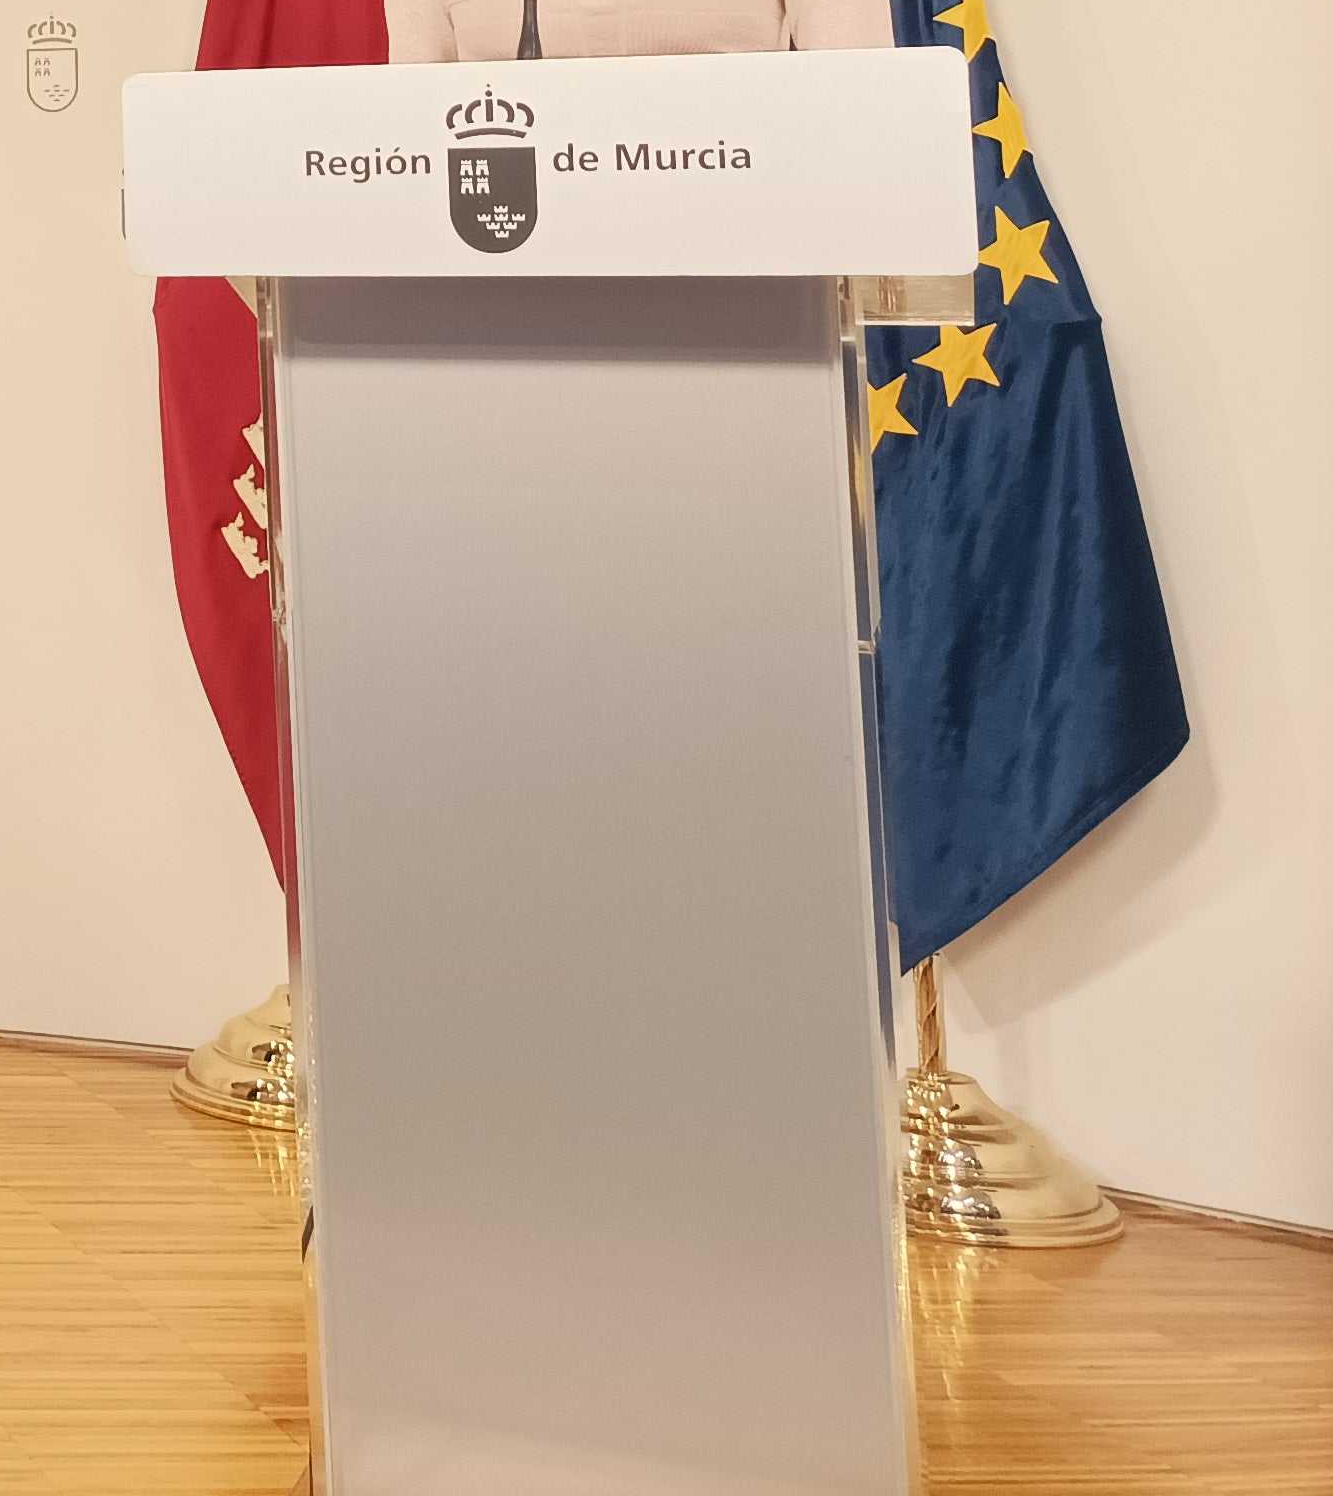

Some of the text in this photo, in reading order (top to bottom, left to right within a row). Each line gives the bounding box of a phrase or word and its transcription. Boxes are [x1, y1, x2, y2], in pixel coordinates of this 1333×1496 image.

[305, 139, 753, 184] Región de Murcia
